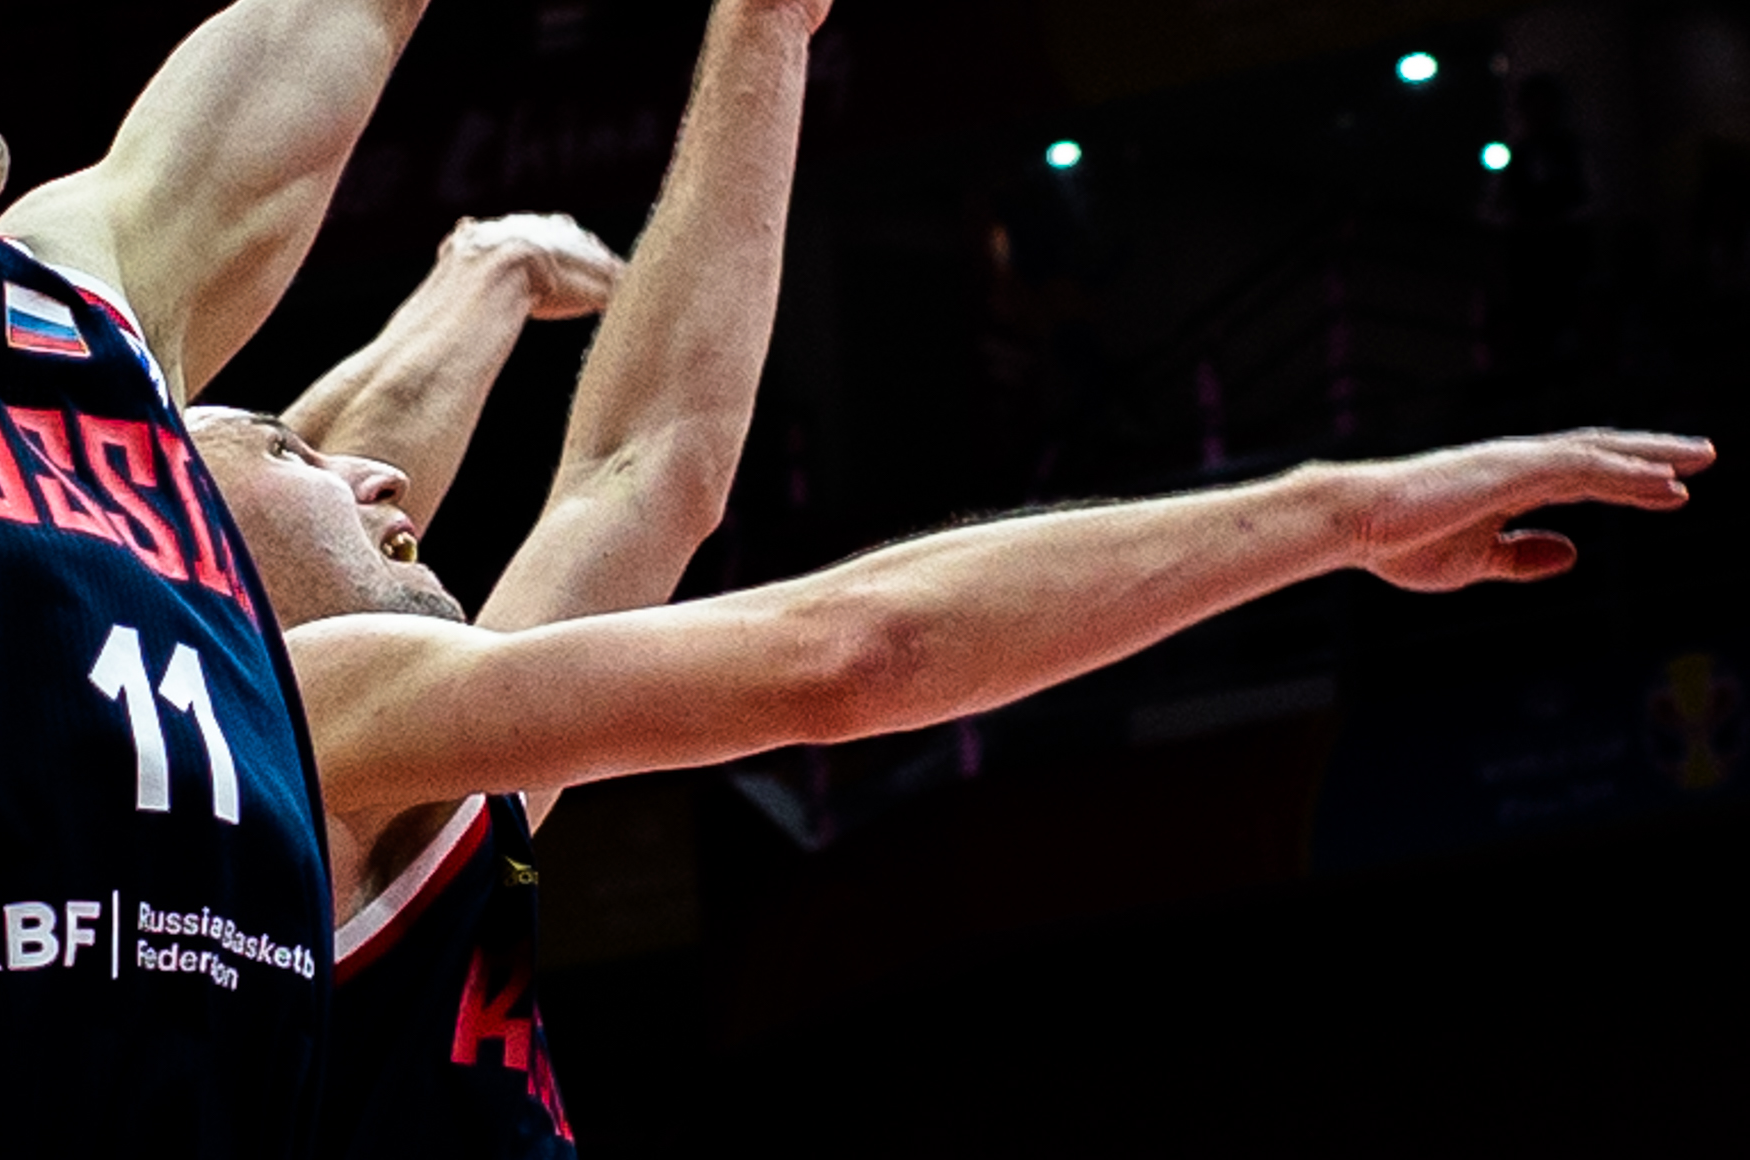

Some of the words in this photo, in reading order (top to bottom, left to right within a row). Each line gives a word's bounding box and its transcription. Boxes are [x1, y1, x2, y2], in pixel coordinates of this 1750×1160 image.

[88, 625, 239, 825] 11
[137, 901, 223, 939] Russia
[222, 919, 315, 980] Basketb
